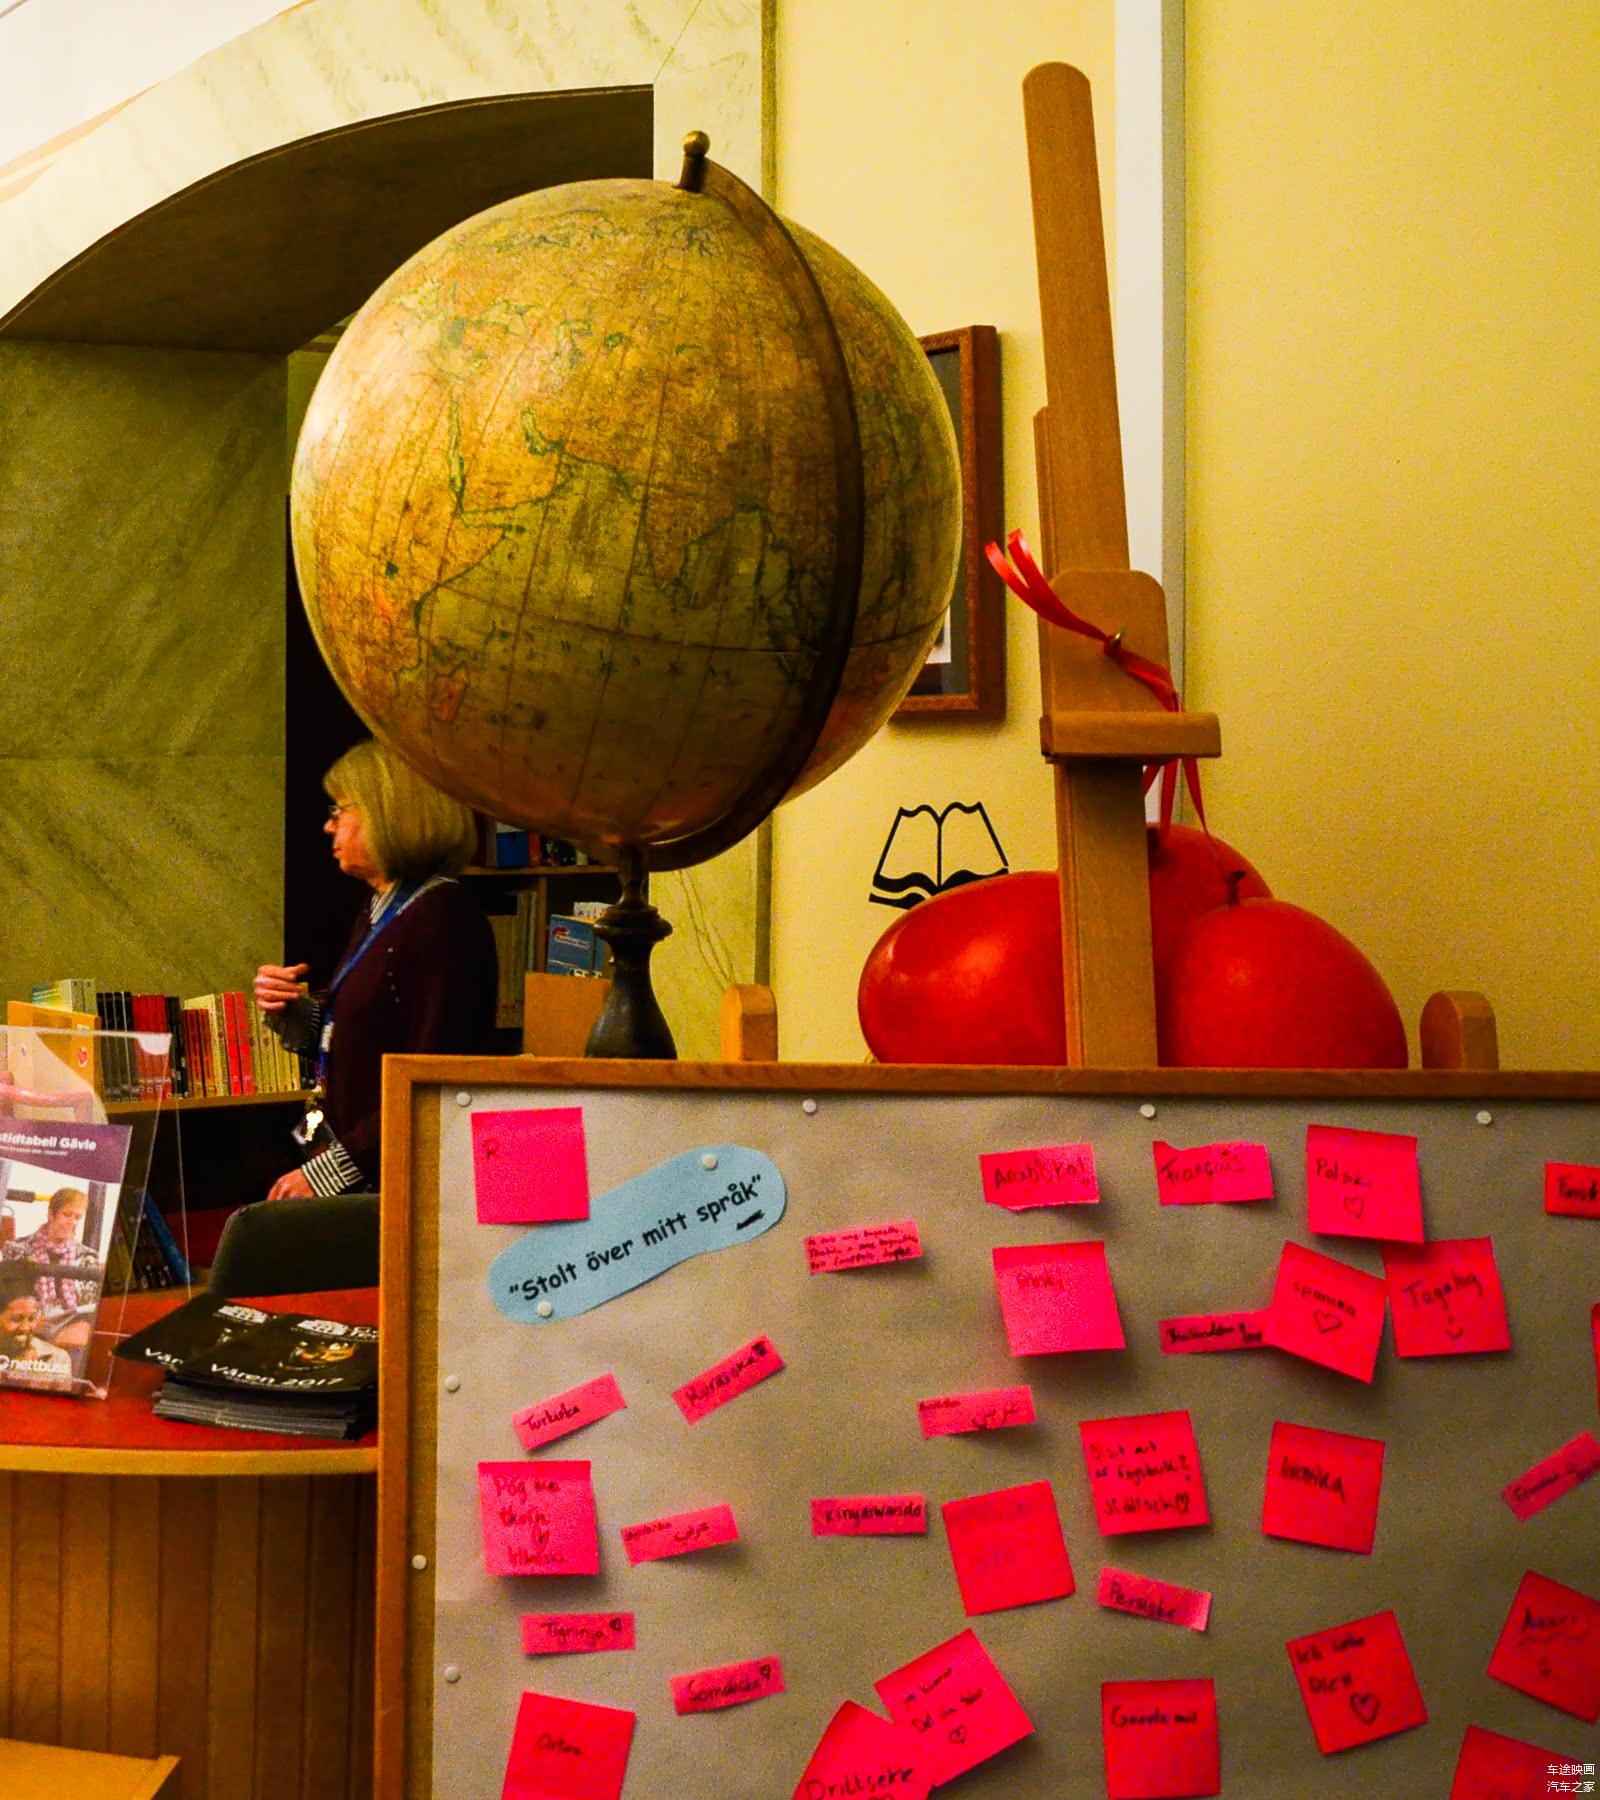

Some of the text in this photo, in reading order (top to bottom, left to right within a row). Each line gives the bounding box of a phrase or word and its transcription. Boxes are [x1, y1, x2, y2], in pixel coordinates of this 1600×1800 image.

[60, 1137, 97, 1151] Gävle
[586, 1240, 634, 1271] över
[642, 1211, 687, 1248] mitt
[11, 1358, 70, 1375] nettbuss
[211, 1363, 276, 1384] Våren
[280, 1376, 345, 1387] 2017
